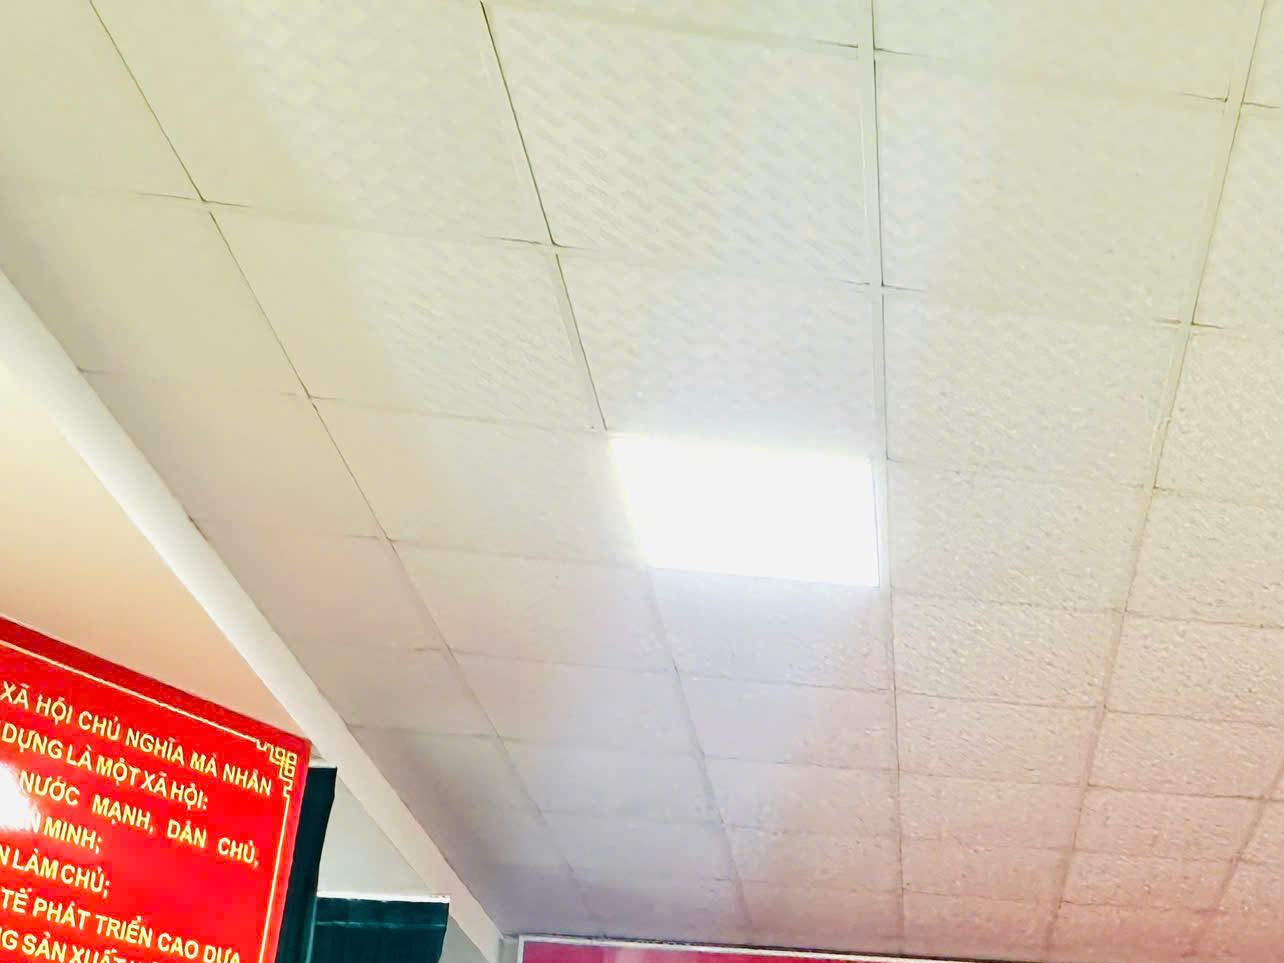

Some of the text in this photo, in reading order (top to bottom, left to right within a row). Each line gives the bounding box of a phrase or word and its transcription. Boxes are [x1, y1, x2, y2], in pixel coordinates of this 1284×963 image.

[2, 722, 63, 759] DỰNG
[66, 744, 92, 771] LÀ
[96, 755, 141, 786] MỘT
[141, 770, 167, 797] XÃ
[36, 694, 73, 725] HỘI
[78, 711, 121, 741] CHỦ
[125, 727, 185, 766] NGHĨA
[222, 763, 272, 796] NHÂN
[20, 770, 80, 806] NƯỚC
[167, 819, 206, 848] DÂN
[12, 848, 59, 880] LÀM
[22, 931, 67, 963] SẢN
[32, 898, 91, 931] PHÁT
[96, 916, 152, 948] TRIỂN
[157, 932, 198, 960] CAO
